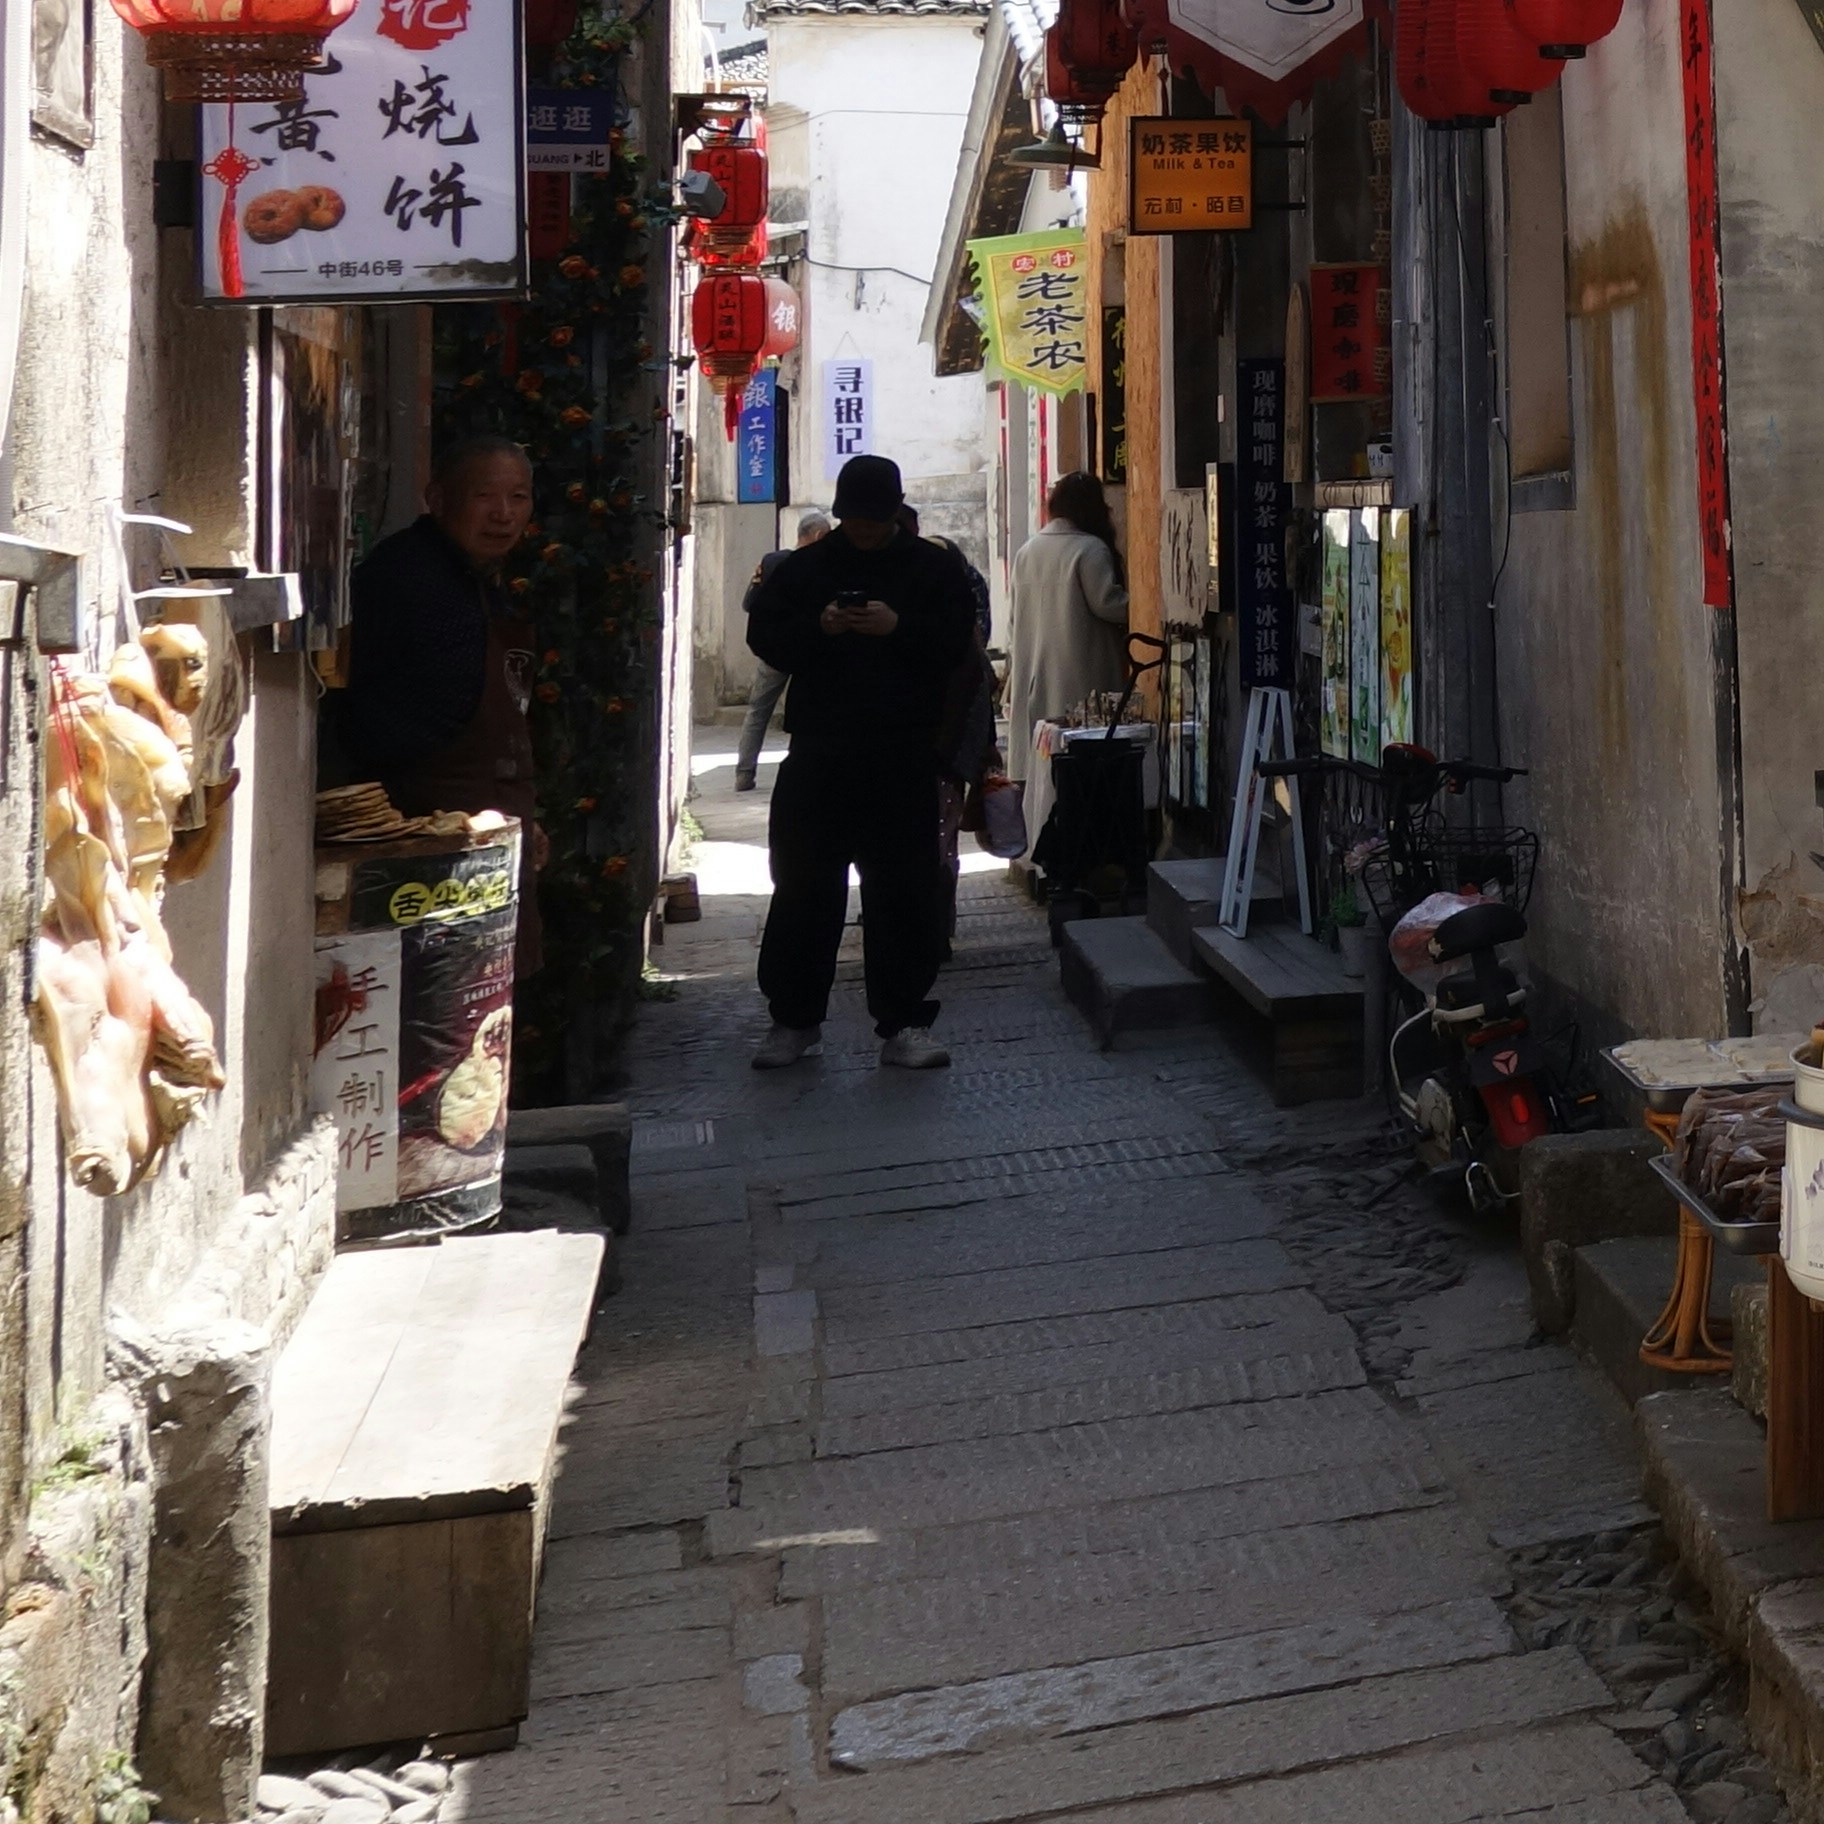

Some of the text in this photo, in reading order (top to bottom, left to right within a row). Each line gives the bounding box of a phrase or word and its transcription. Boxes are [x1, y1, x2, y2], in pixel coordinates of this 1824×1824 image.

[249, 50, 344, 166] 黄
[528, 105, 593, 132] 逛逛
[378, 64, 482, 249] 烧饼
[585, 150, 605, 167] 北
[1141, 132, 1247, 156] 奶茶果饮
[1152, 157, 1236, 170] Milk & Tea
[318, 259, 405, 279] 中街46号
[1016, 271, 1086, 370] 老茶农
[832, 366, 865, 455] 寻银记
[336, 966, 389, 1173] 手工制作
